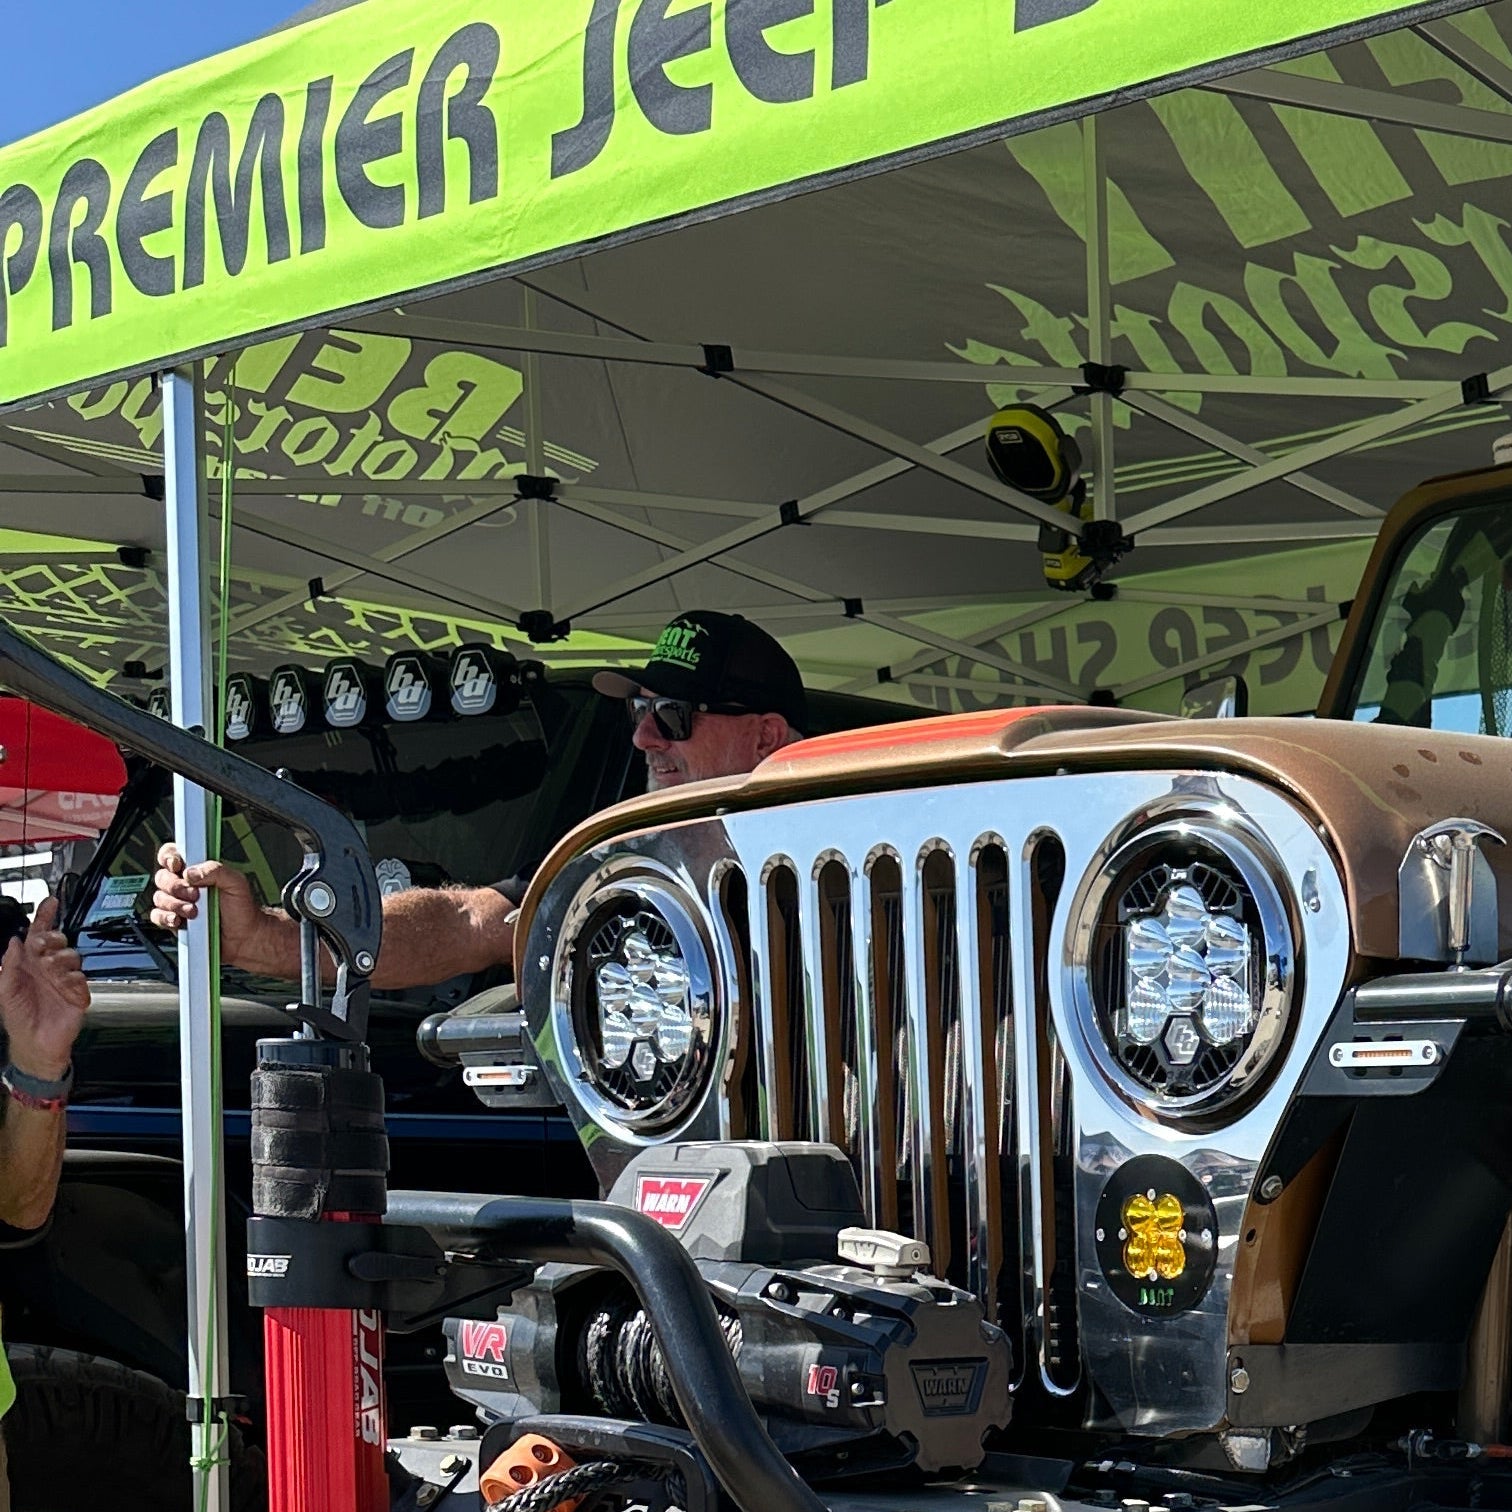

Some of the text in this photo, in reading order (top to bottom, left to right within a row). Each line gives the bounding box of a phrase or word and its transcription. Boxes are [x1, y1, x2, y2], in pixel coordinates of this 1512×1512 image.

[0, 22, 500, 348] PREMIER
[643, 1193, 691, 1214] WARN
[247, 1256, 290, 1274] OJAB
[462, 1319, 508, 1363] VR
[465, 1362, 506, 1378] EVO
[807, 1364, 838, 1397] 10
[923, 1377, 968, 1398] WARN
